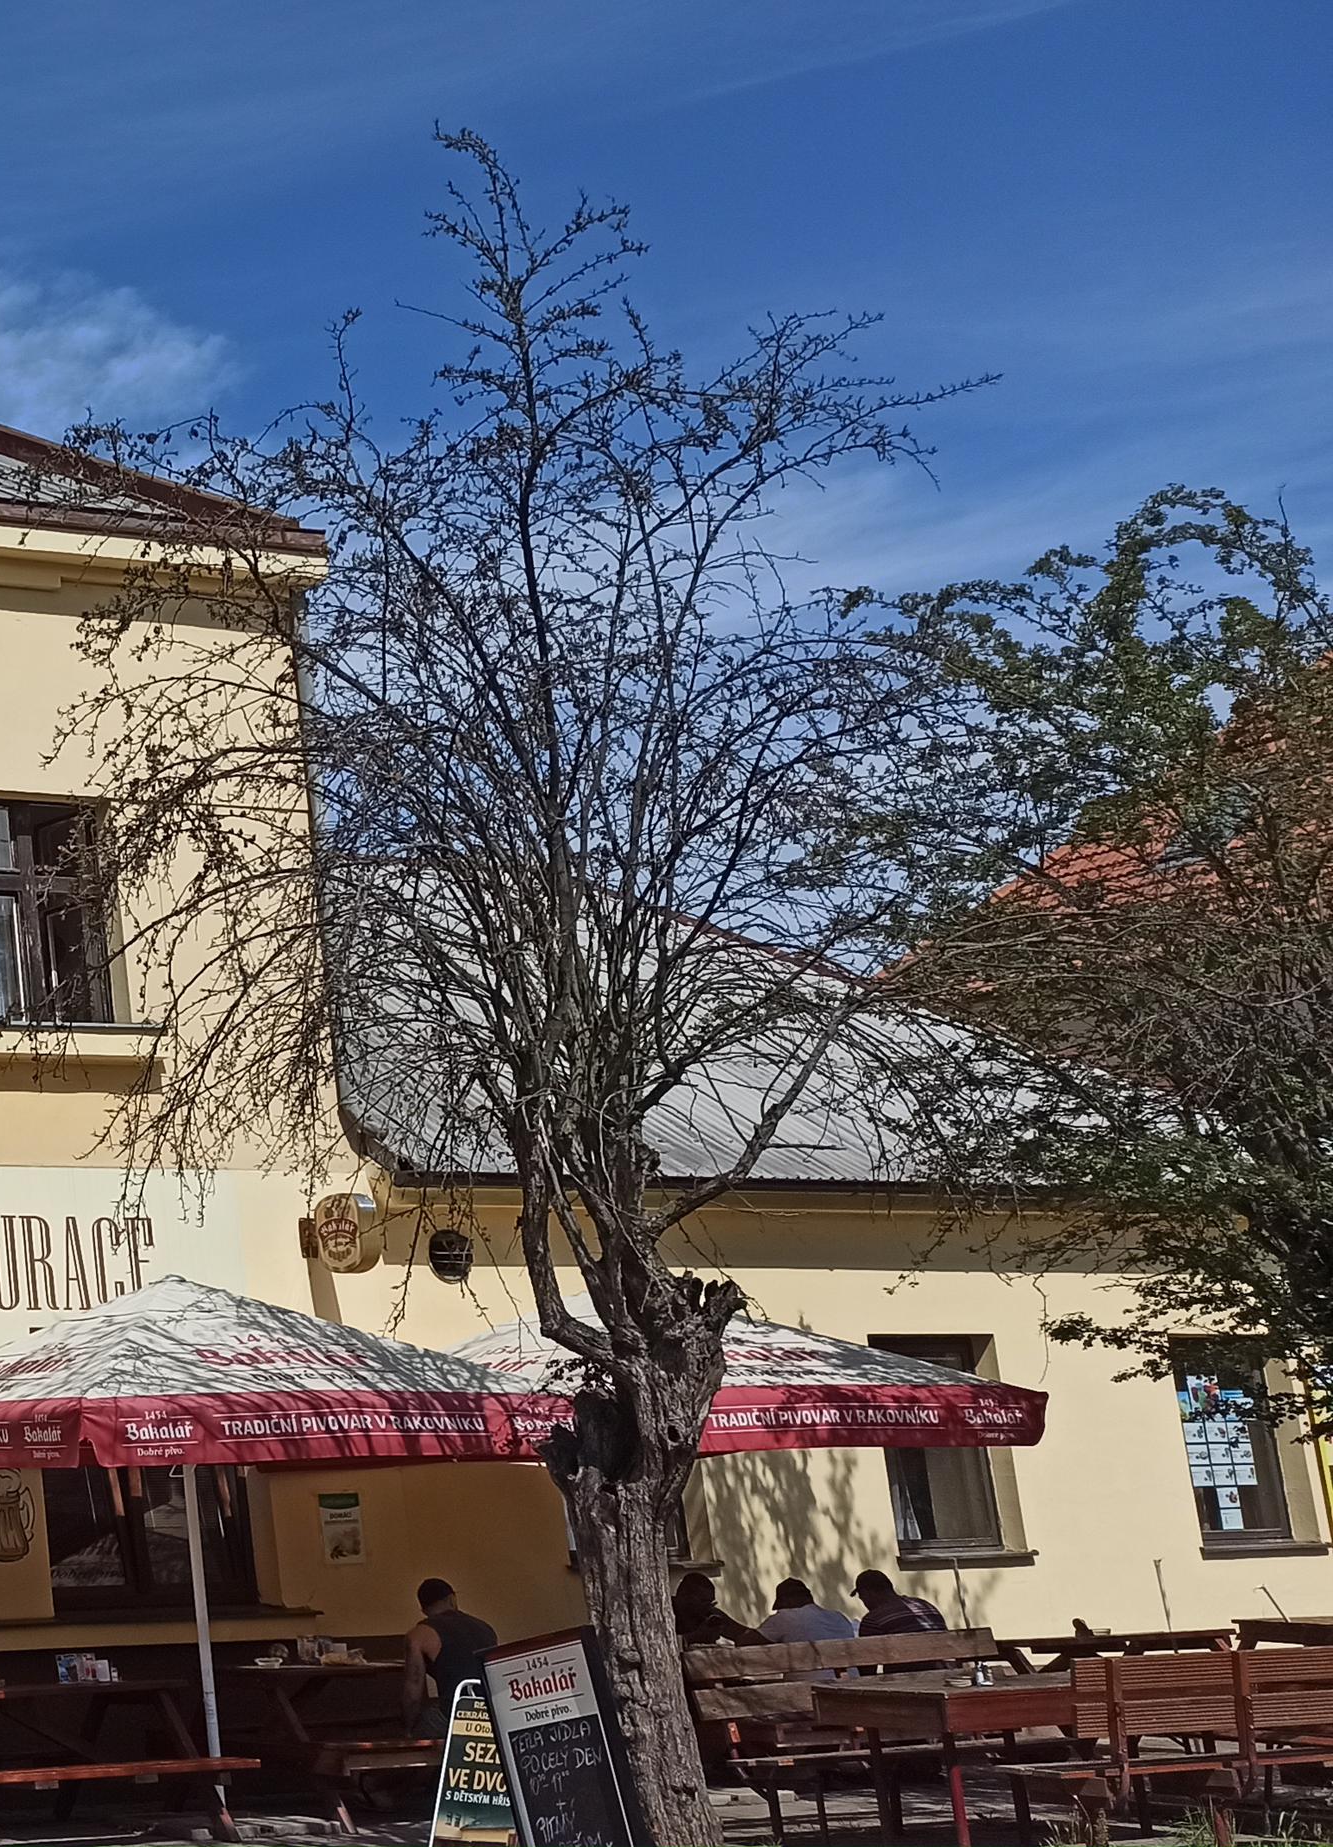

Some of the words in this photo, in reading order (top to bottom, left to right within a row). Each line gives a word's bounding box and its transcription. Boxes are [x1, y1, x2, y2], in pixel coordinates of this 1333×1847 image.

[143, 1410, 168, 1420] 1454
[221, 1413, 298, 1437] TRADIČNÍ
[301, 1413, 373, 1433] PIVOVAR
[374, 1414, 387, 1430] V
[390, 1412, 485, 1432] RAKOVNÍKU
[709, 1408, 776, 1428] TRADIČNÍ
[780, 1408, 840, 1426] PIVOVAR
[843, 1409, 855, 1424] V
[857, 1405, 939, 1424] RAKOVNÍKU
[24, 1426, 62, 1443] Bakalář
[125, 1420, 194, 1440] Bakalář
[137, 1446, 163, 1457] Dobré
[165, 1446, 186, 1458] pivo.
[525, 1656, 550, 1671] 1454
[508, 1666, 577, 1702] Bakalář
[456, 1710, 490, 1720] CUKRÁR
[525, 1706, 550, 1722] Dobré
[551, 1704, 572, 1720] pivo.
[463, 1741, 501, 1764] SEZ
[571, 1744, 603, 1769] DEN
[449, 1767, 469, 1790] VE
[473, 1770, 507, 1793] DVO
[445, 1790, 452, 1800] S
[453, 1790, 490, 1805] DĚTSKÝM
